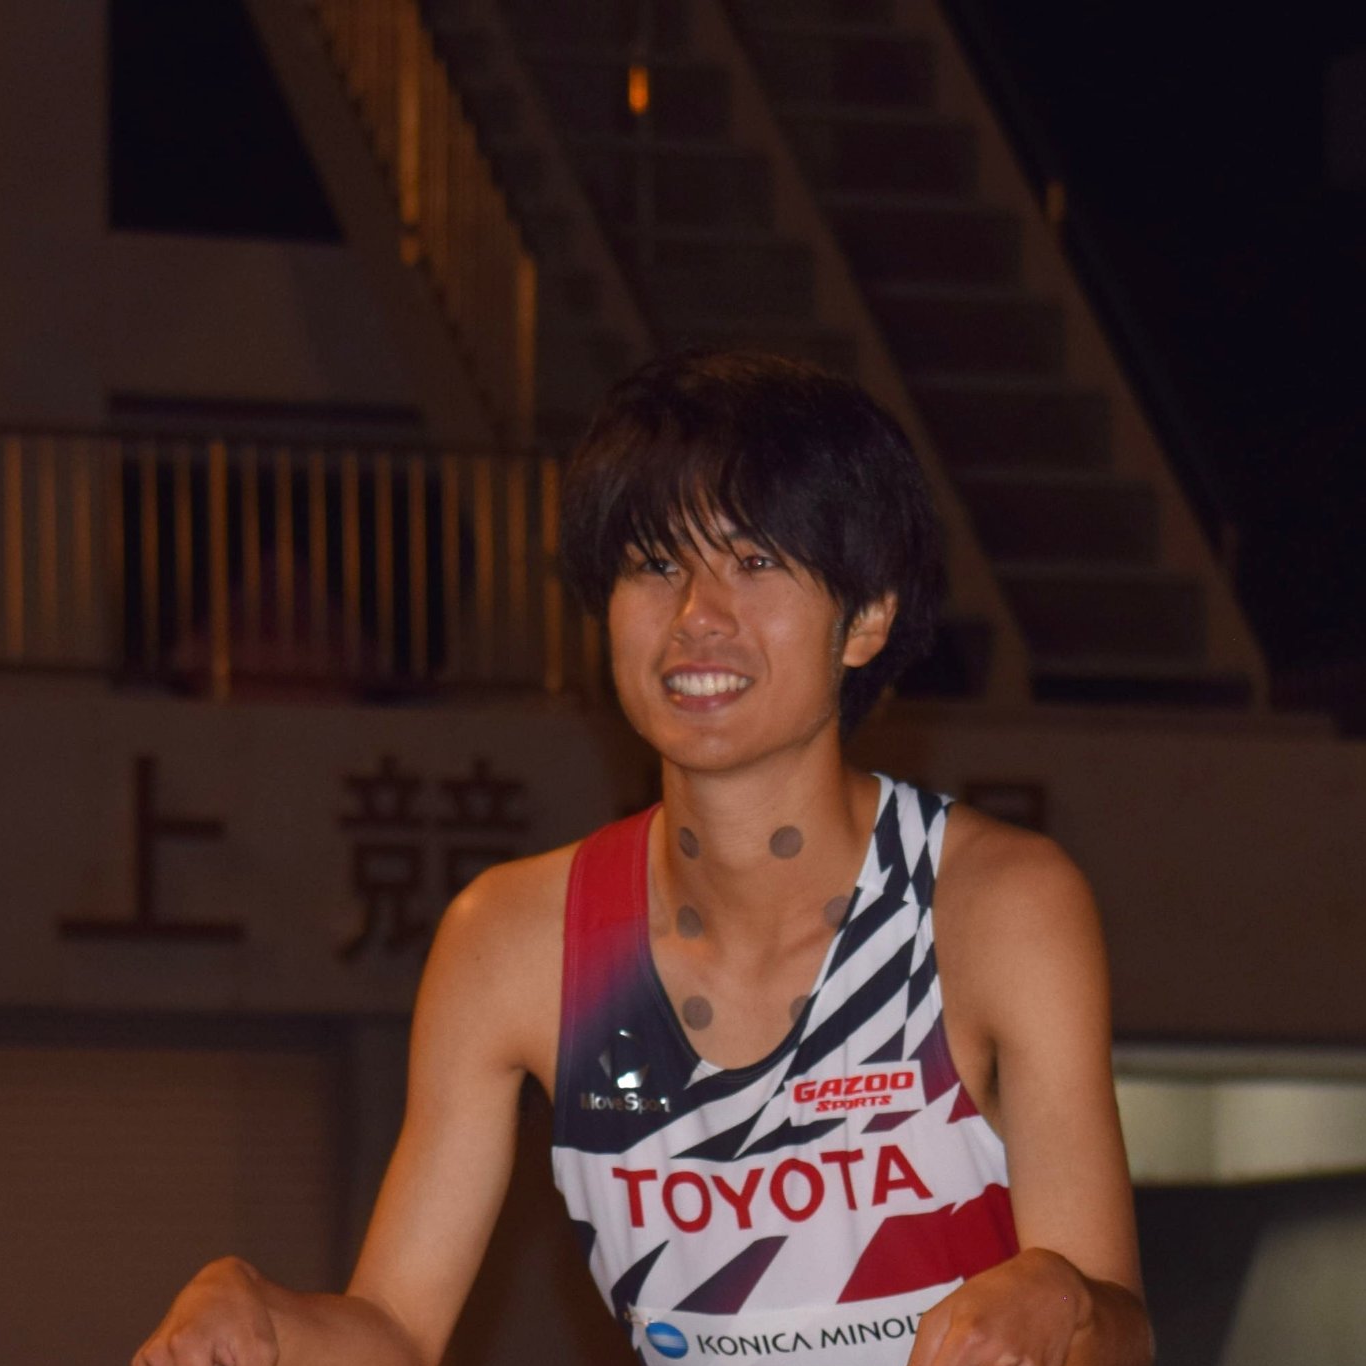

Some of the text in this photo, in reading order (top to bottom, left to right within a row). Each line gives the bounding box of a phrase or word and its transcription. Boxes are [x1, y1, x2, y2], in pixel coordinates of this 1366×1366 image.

[793, 1071, 914, 1104] GAZOO
[816, 1095, 892, 1112] SPORTS
[611, 1145, 933, 1233] TOYOTA
[697, 1331, 812, 1356] KONICA
